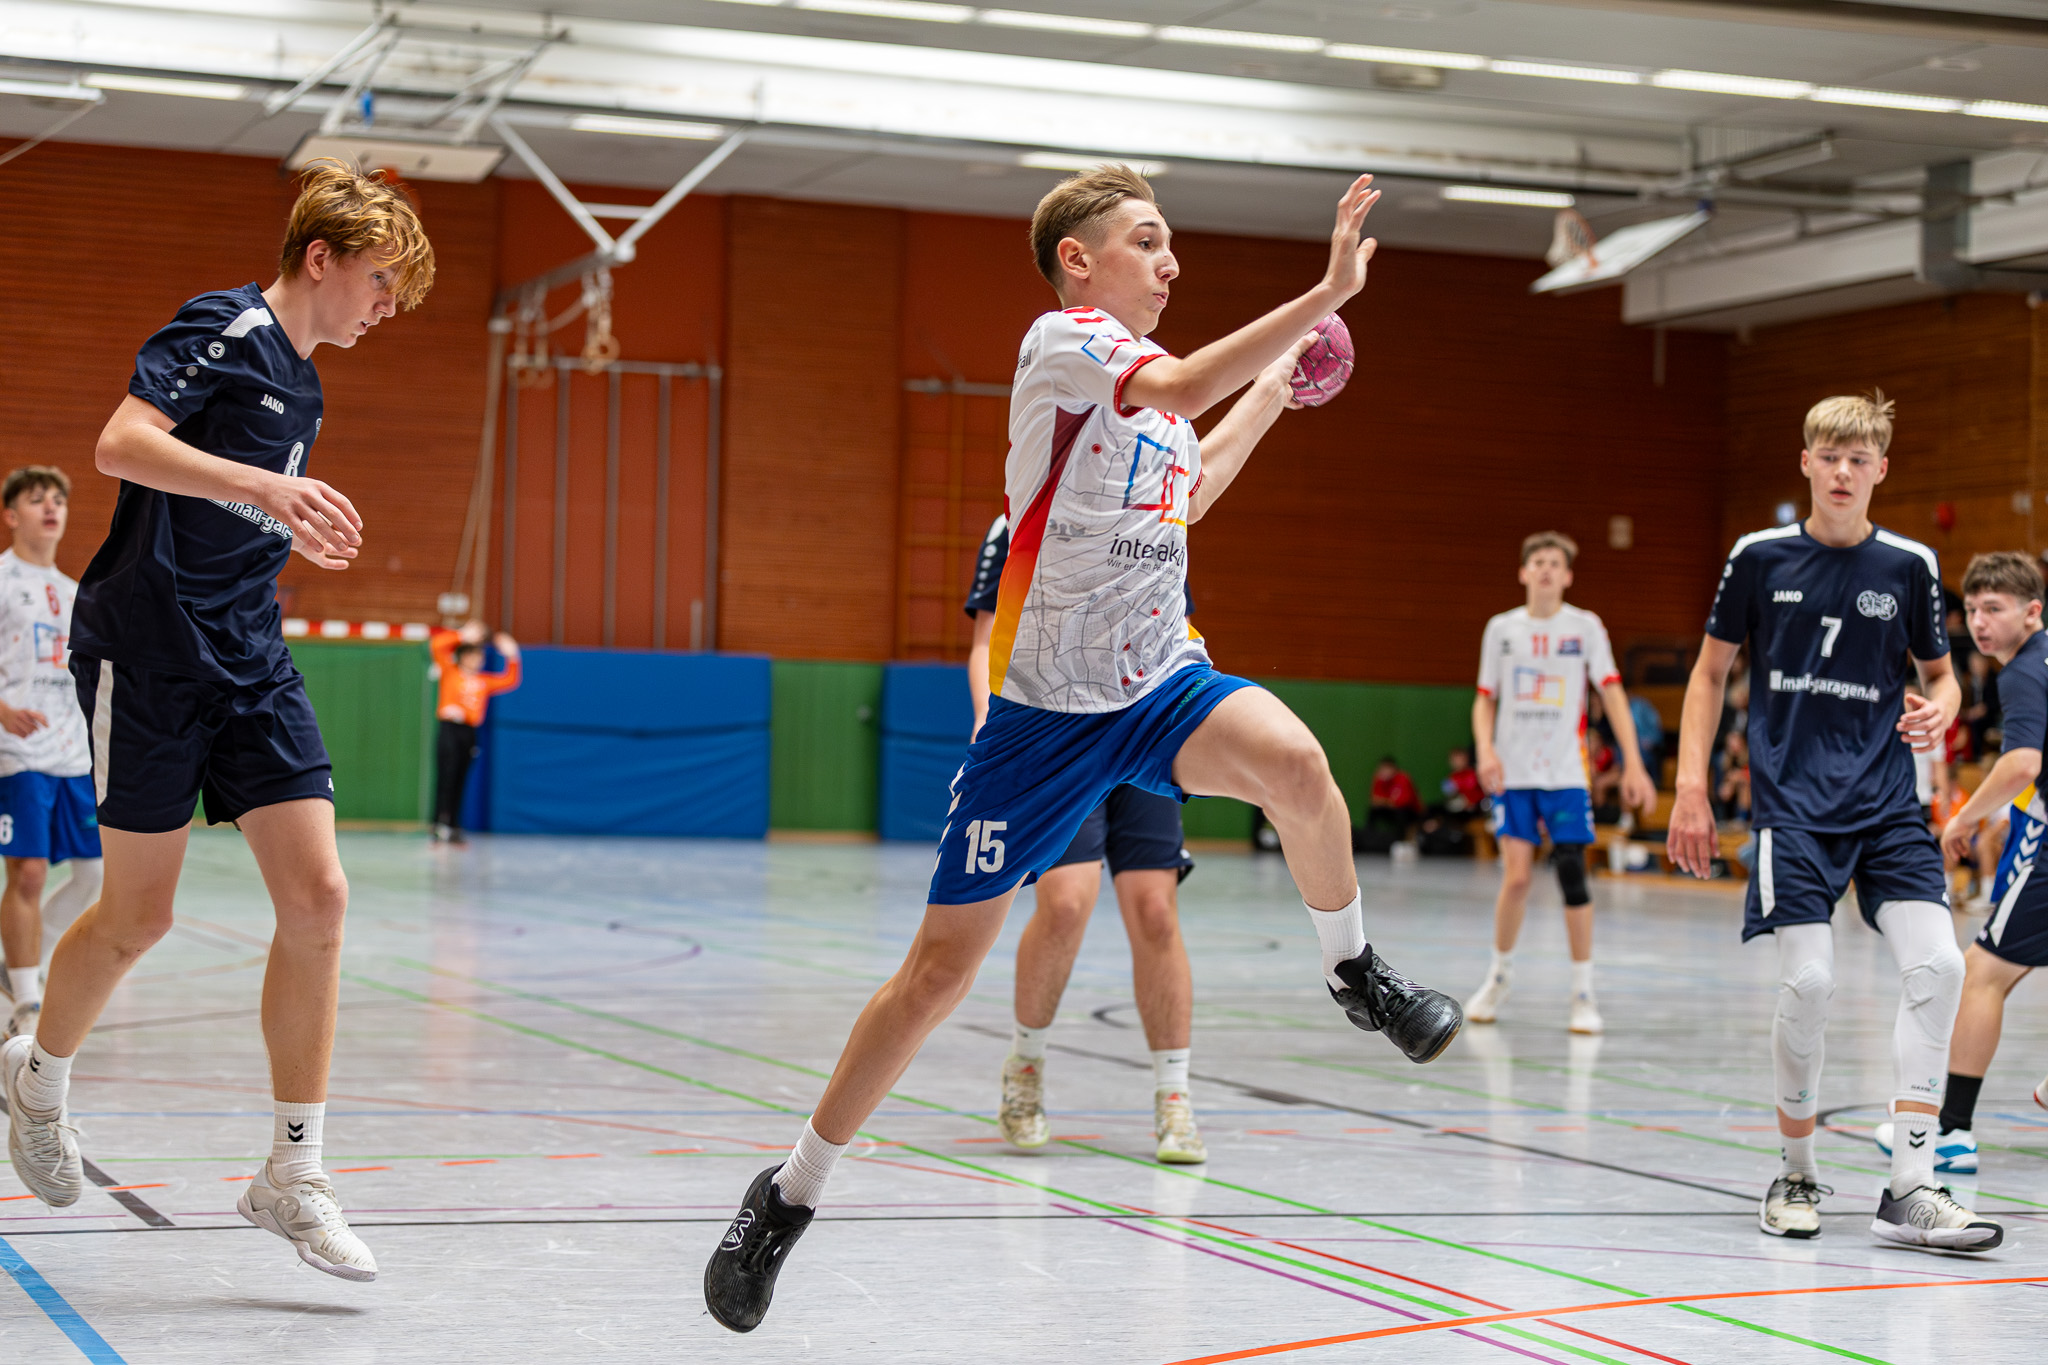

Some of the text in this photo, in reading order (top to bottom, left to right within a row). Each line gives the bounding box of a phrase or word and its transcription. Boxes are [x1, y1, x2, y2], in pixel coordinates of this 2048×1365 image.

[260, 393, 285, 415] JAKO
[1772, 590, 1803, 603] JAKO
[1821, 616, 1843, 658] 7
[965, 819, 1007, 875] 15
